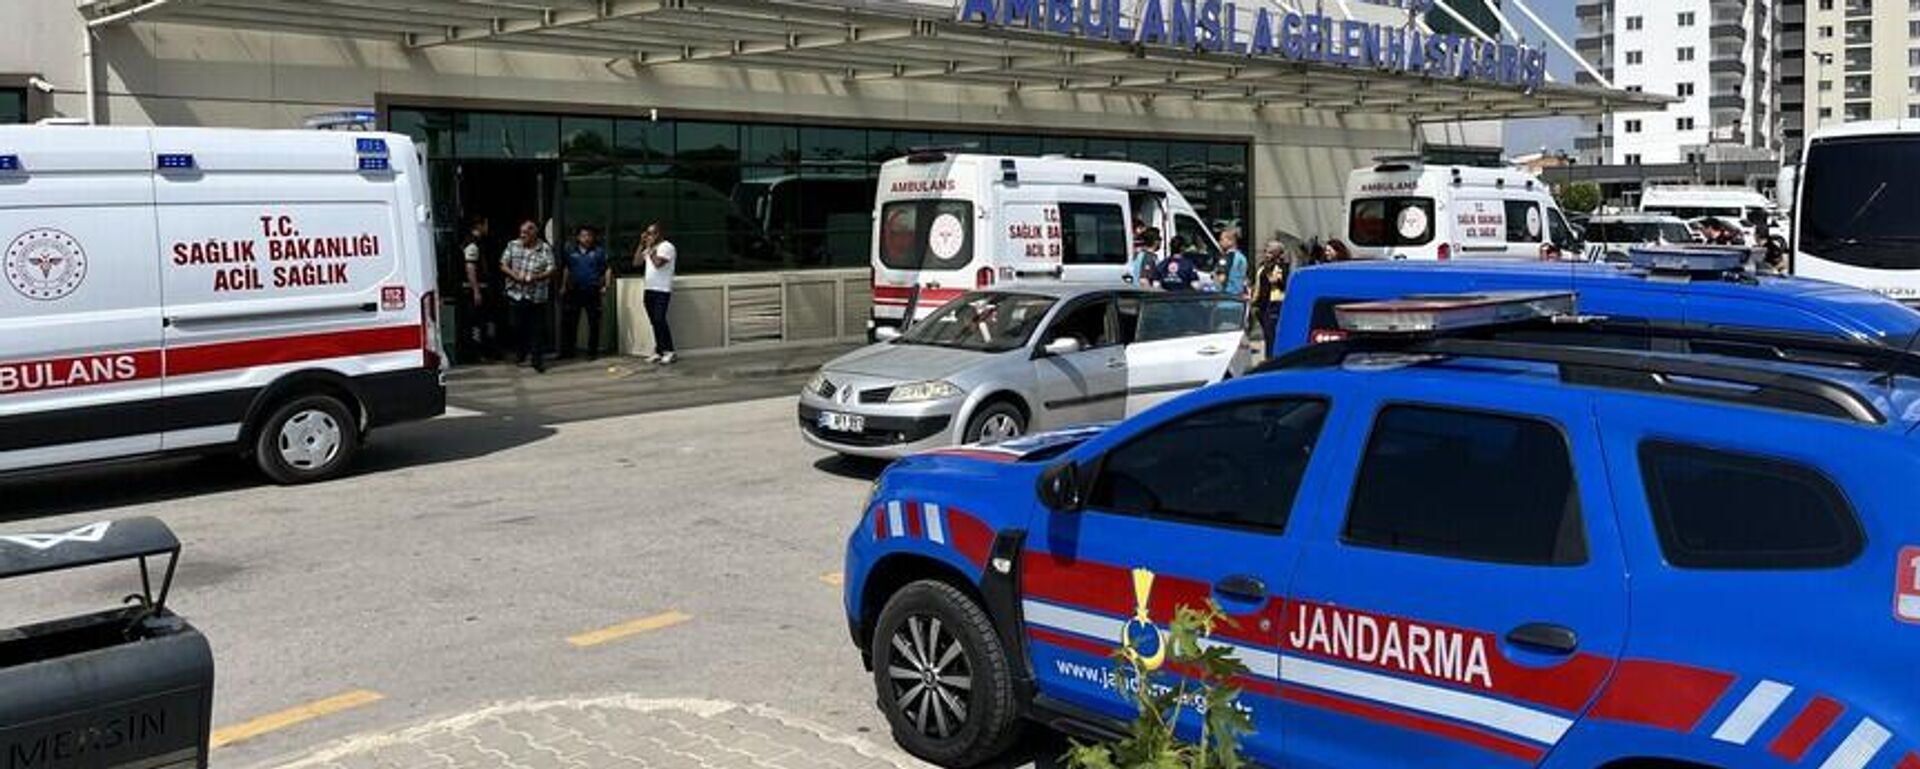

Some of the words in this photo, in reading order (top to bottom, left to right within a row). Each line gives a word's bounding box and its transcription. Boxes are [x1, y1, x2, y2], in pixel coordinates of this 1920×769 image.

[890, 179, 956, 193] AMBULANS
[261, 216, 300, 237] T.C.
[173, 239, 255, 265] SAĞLIK
[269, 232, 379, 261] BAKANLIĞI
[214, 264, 264, 291] ACİL
[273, 261, 347, 288] SAĞLIK
[1290, 604, 1493, 688] JANDARMA
